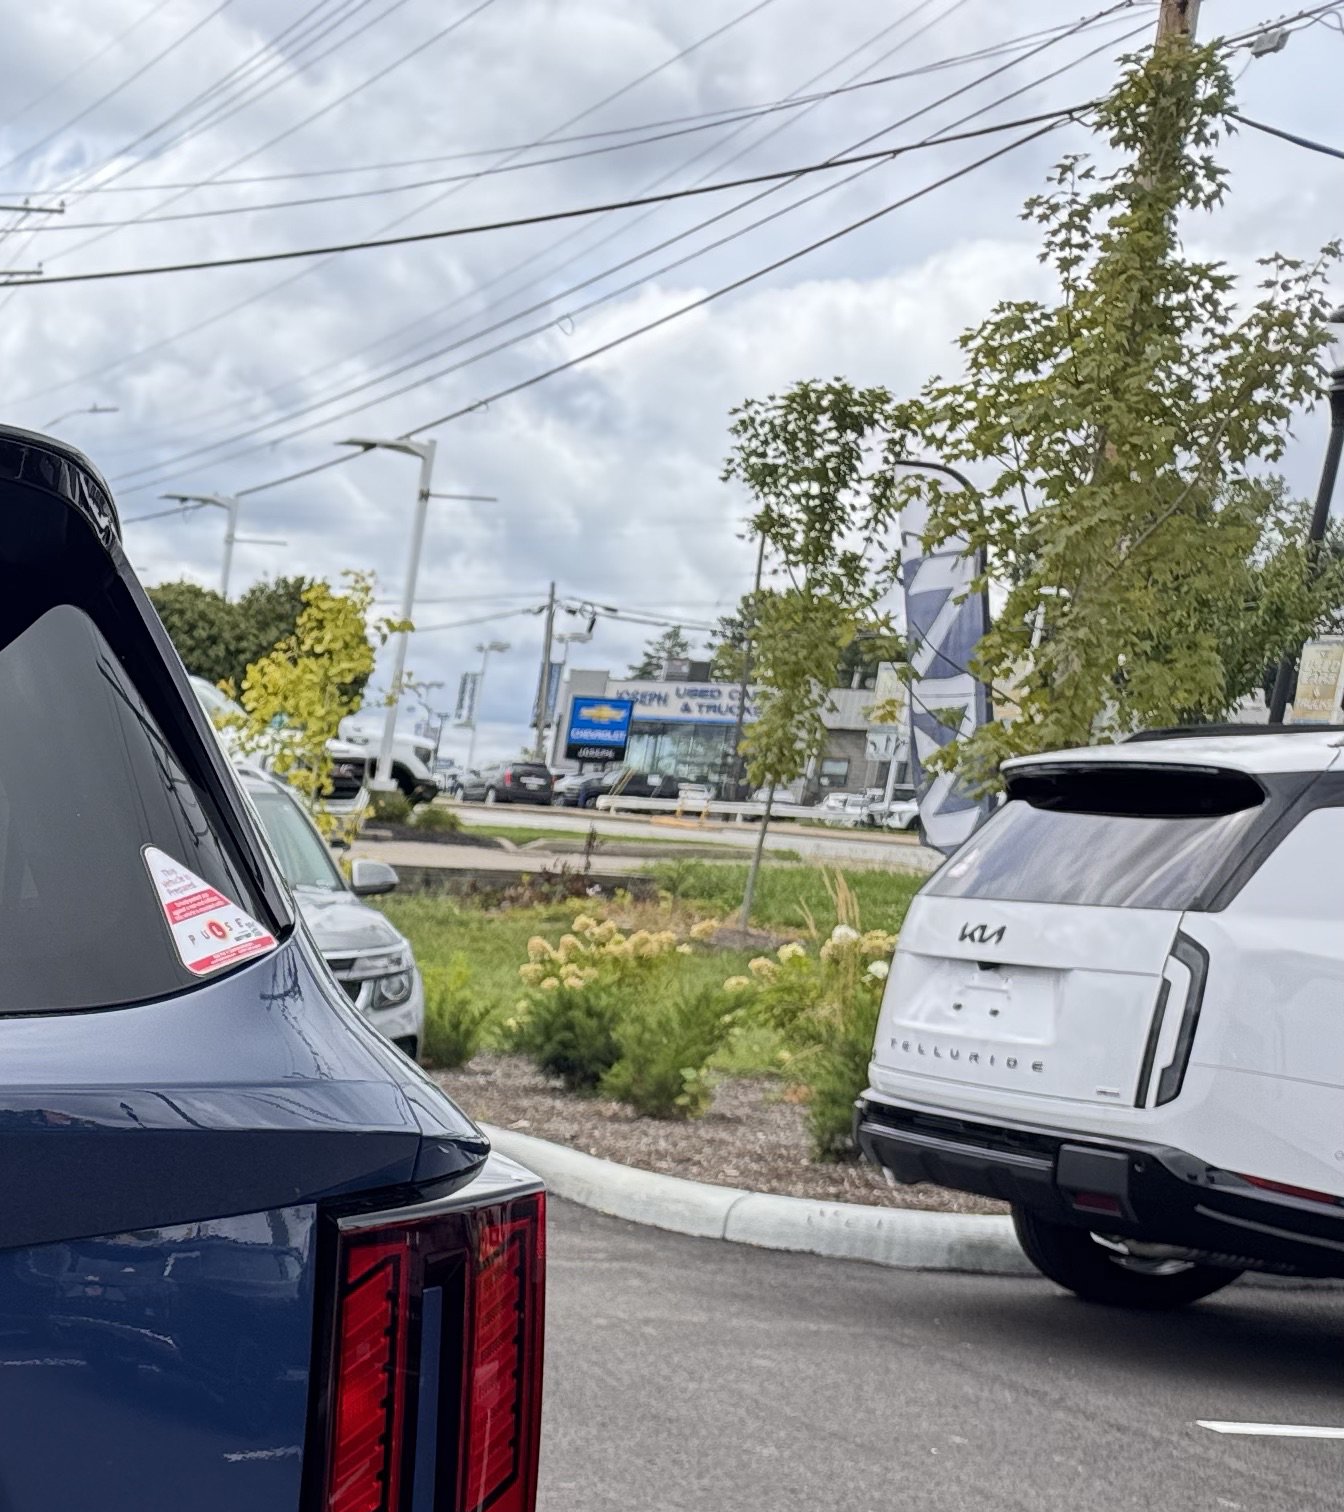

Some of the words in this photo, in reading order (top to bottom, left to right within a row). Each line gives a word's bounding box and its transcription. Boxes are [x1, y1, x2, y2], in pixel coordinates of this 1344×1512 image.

[675, 686, 722, 700] USED
[570, 727, 627, 741] CHEVROLET
[188, 917, 244, 946] PULSE
[958, 921, 1008, 944] KIA
[889, 1037, 1045, 1073] TELLURIDE
